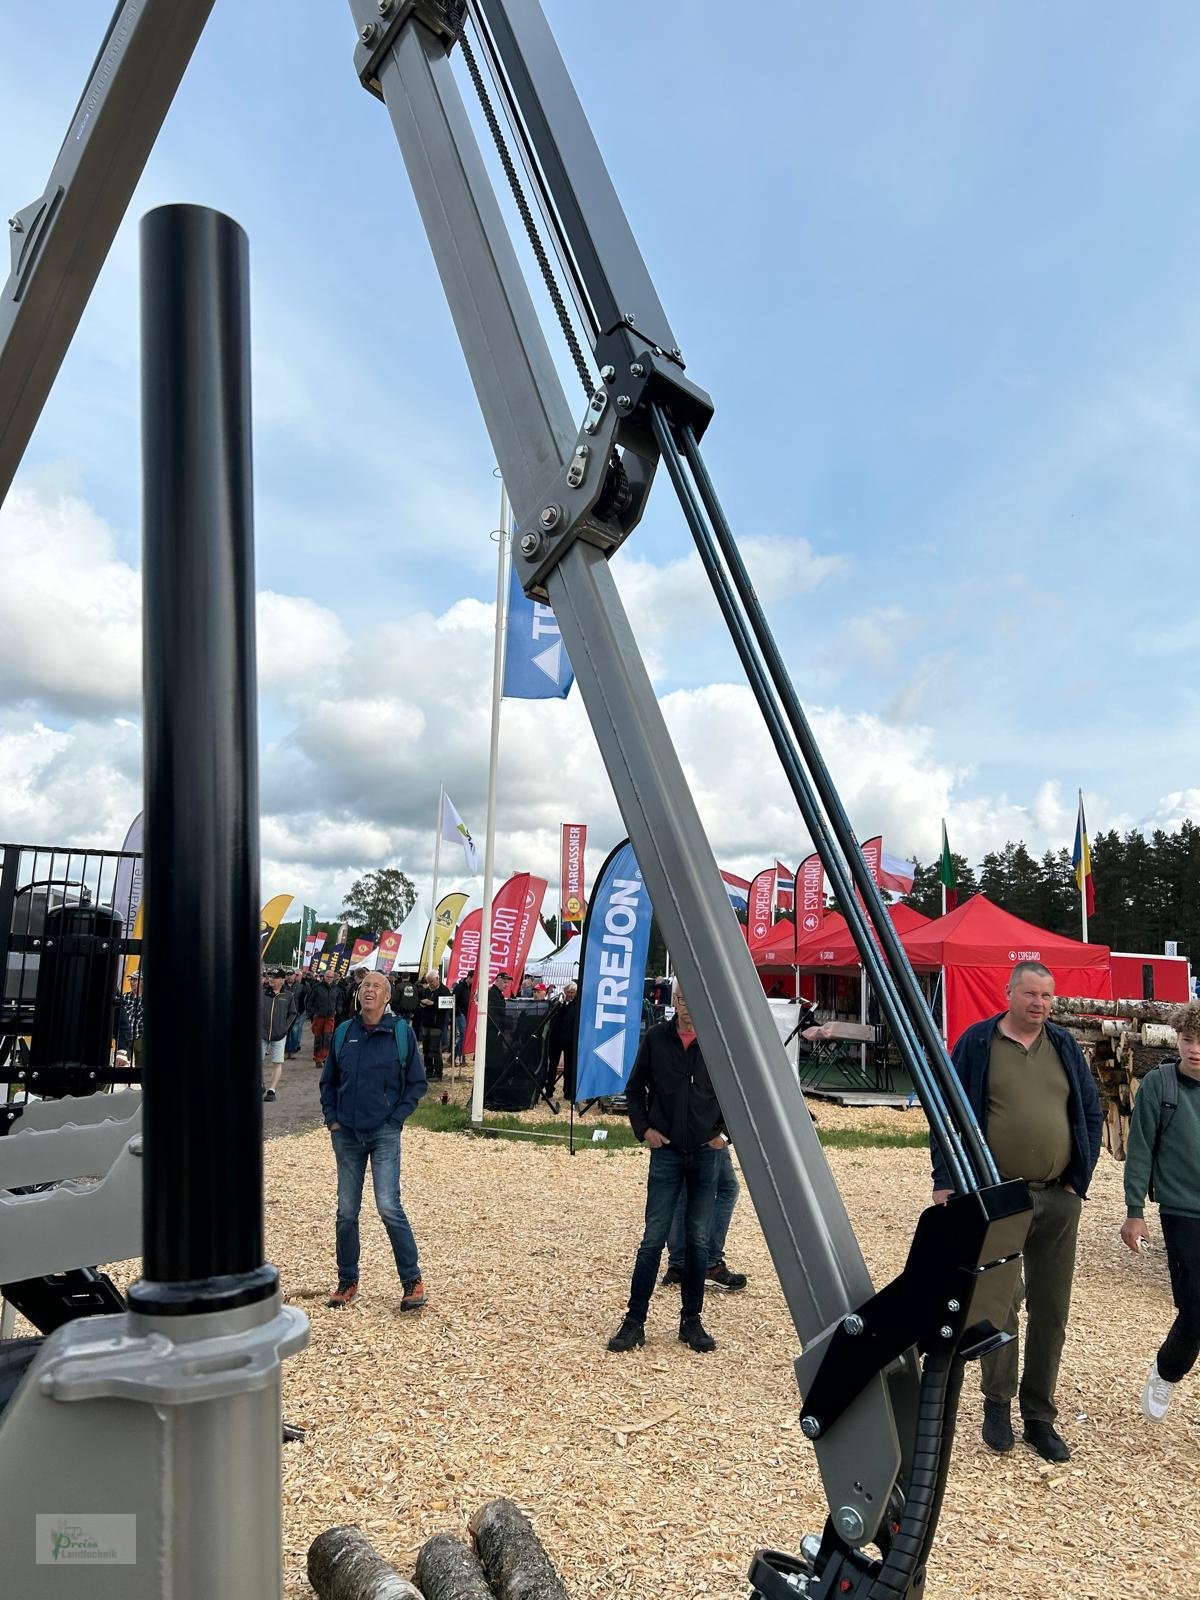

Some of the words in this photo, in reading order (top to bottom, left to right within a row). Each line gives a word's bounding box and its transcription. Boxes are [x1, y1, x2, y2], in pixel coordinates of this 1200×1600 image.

[568, 827, 581, 893] HARGASSNER
[805, 860, 821, 910] ESPEGARD
[756, 876, 771, 920] ESPEGARD
[594, 878, 643, 1029] TREJON
